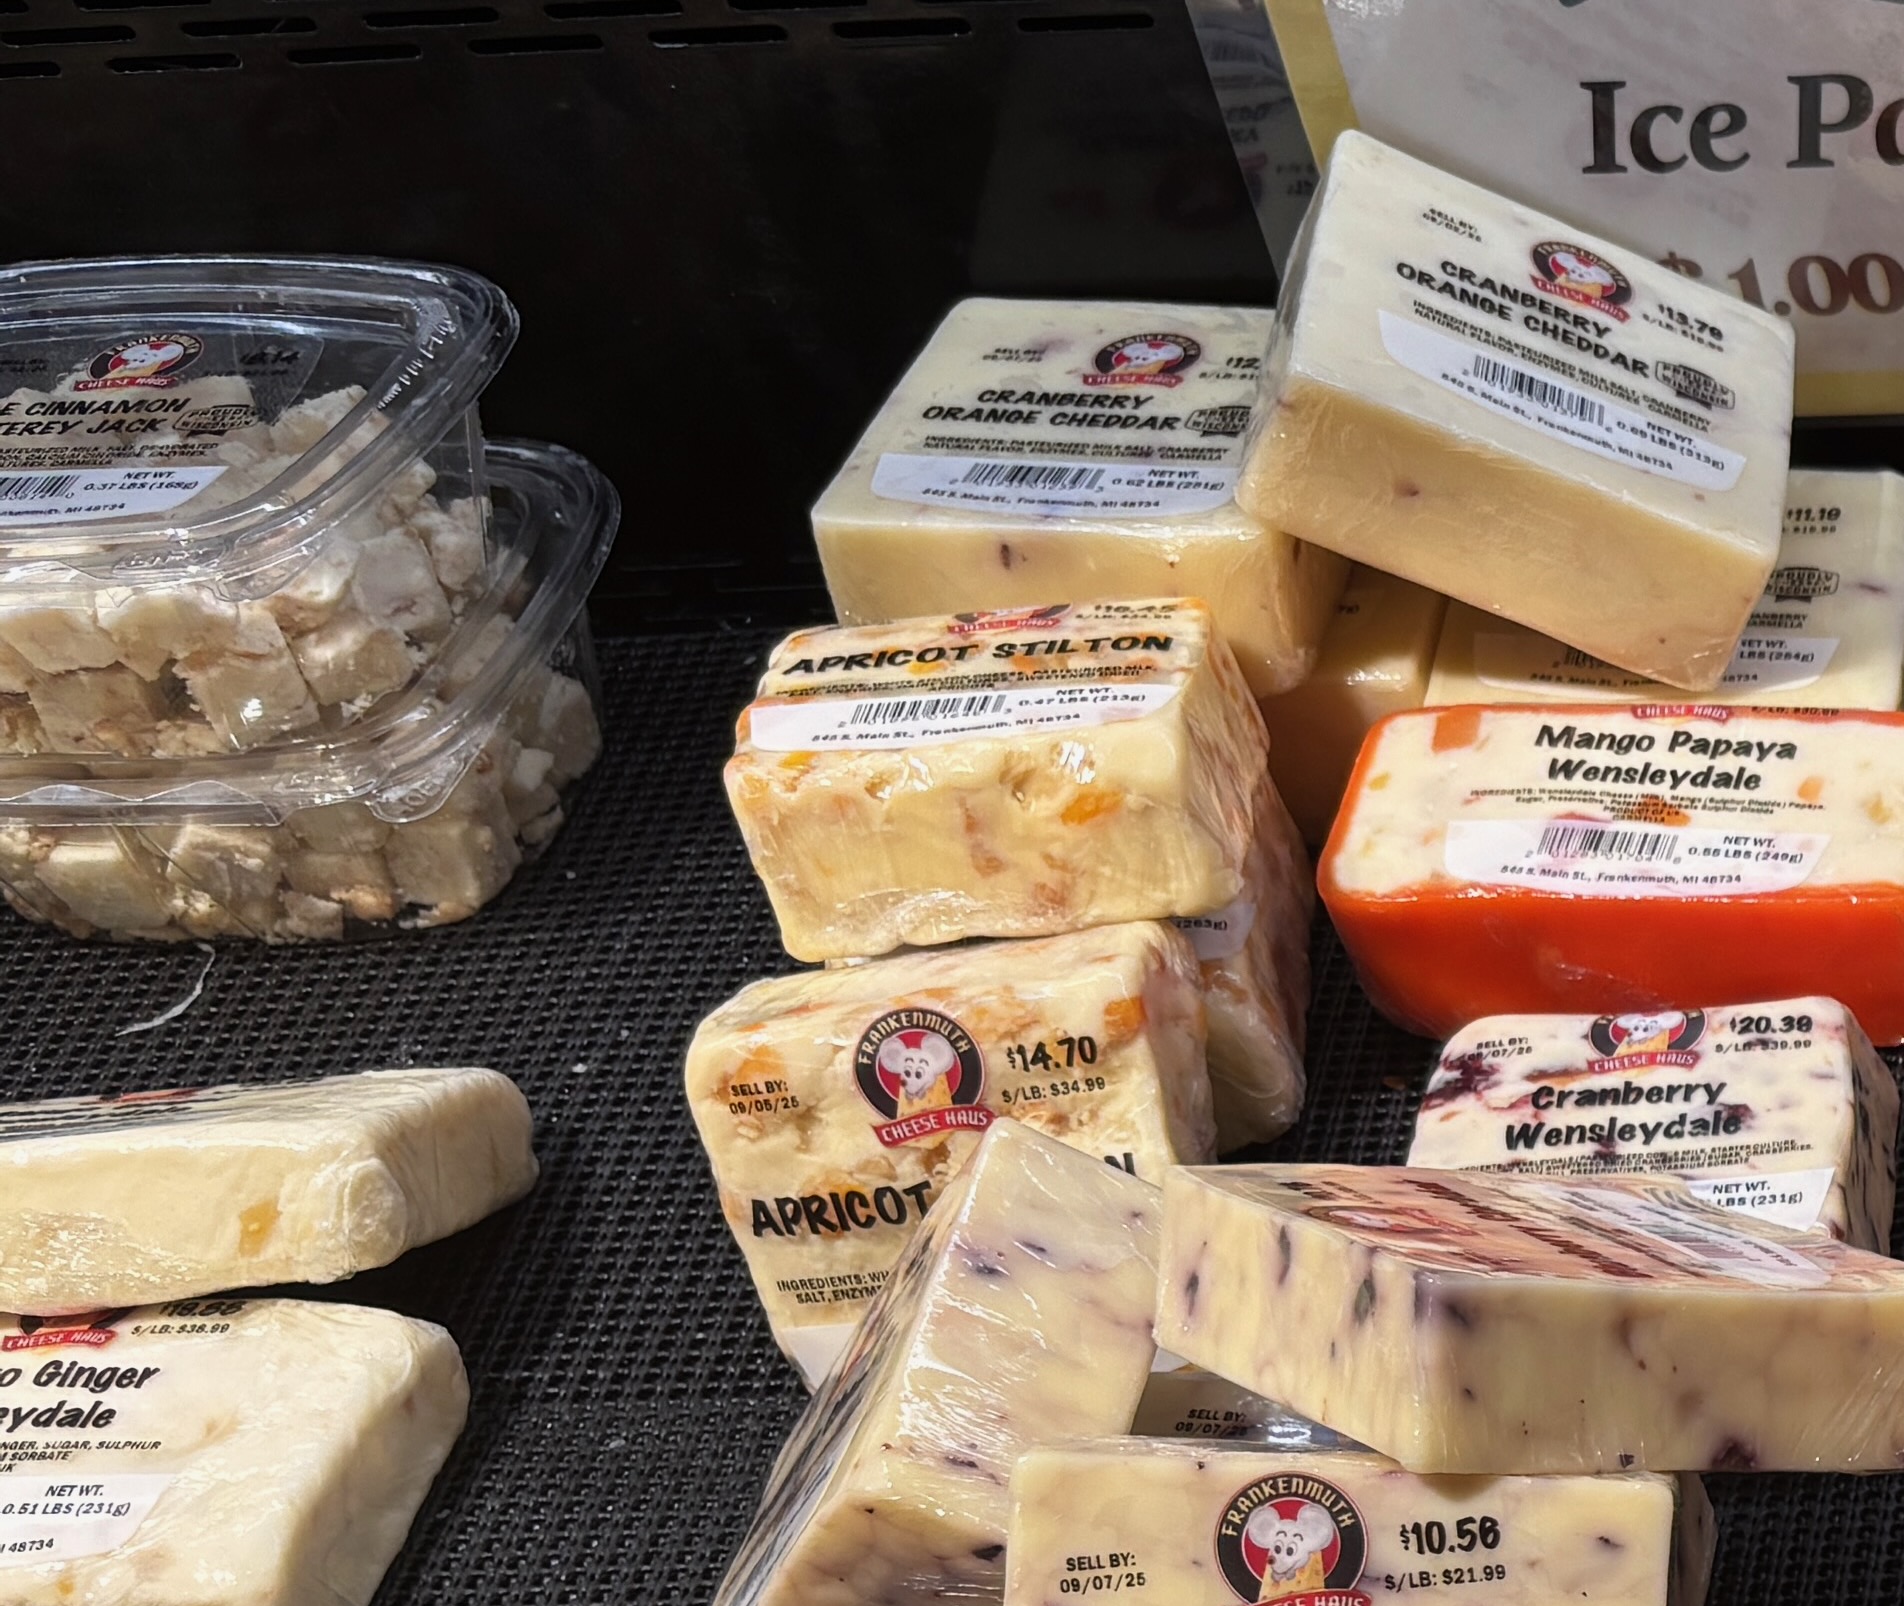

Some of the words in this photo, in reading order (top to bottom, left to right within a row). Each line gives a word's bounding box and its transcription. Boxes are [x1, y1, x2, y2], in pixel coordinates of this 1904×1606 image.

[1579, 79, 1750, 176] Ice
[1440, 260, 1612, 339] CRANBERRY
[1396, 262, 1512, 321] ORANGE
[1523, 315, 1650, 378] CHEDDAR
[25, 398, 191, 416] CINNAMON
[976, 389, 1154, 410] CRANBERRY
[87, 418, 168, 434] JACK
[922, 405, 1042, 425] ORANGE
[1049, 410, 1182, 430] CHEDDAR
[782, 645, 980, 675] APRICOT
[992, 636, 1174, 658] STILTON
[1535, 725, 1656, 753] Mango
[1667, 730, 1798, 761] Papaya
[1547, 758, 1761, 792] Wensleydale
[1006, 1036, 1098, 1072] $14.70
[1531, 1079, 1726, 1111] Cranberry
[1505, 1112, 1742, 1150] Wensleydale
[751, 1182, 932, 1237] APRICOT
[33, 1360, 161, 1393] Ginger
[1059, 1571, 1147, 1593] 09/07/25
